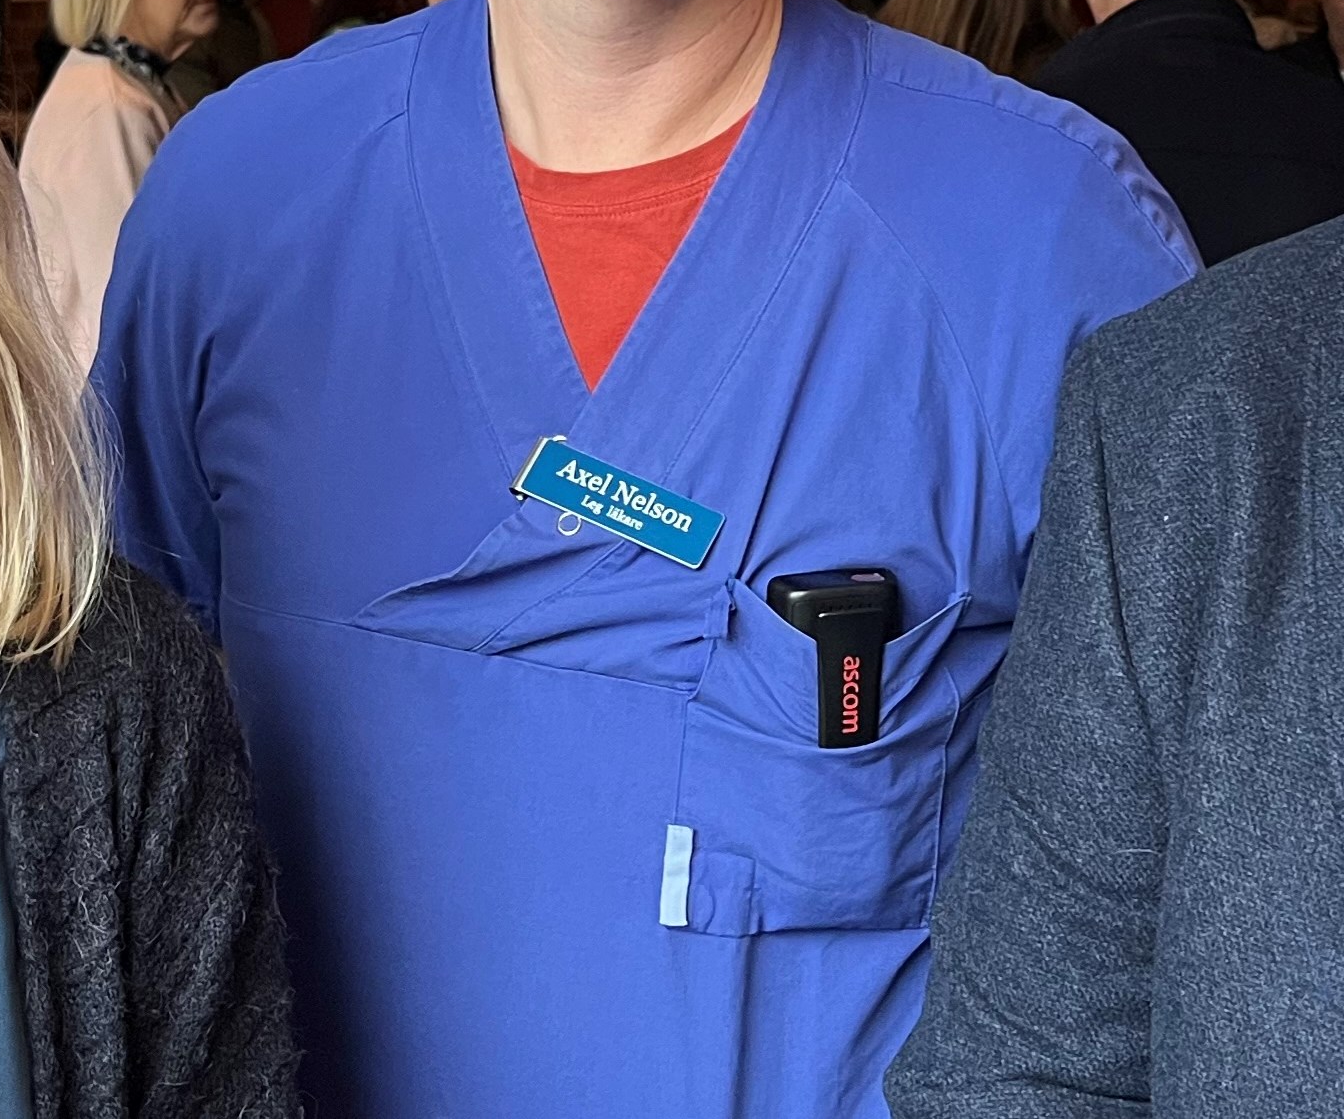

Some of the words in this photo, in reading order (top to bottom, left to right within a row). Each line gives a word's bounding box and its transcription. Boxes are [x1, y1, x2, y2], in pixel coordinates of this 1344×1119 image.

[556, 459, 614, 496] Axel
[611, 480, 693, 533] Nelson
[580, 494, 605, 515] Leg
[605, 504, 644, 531] läkare
[842, 655, 860, 734] ascom
